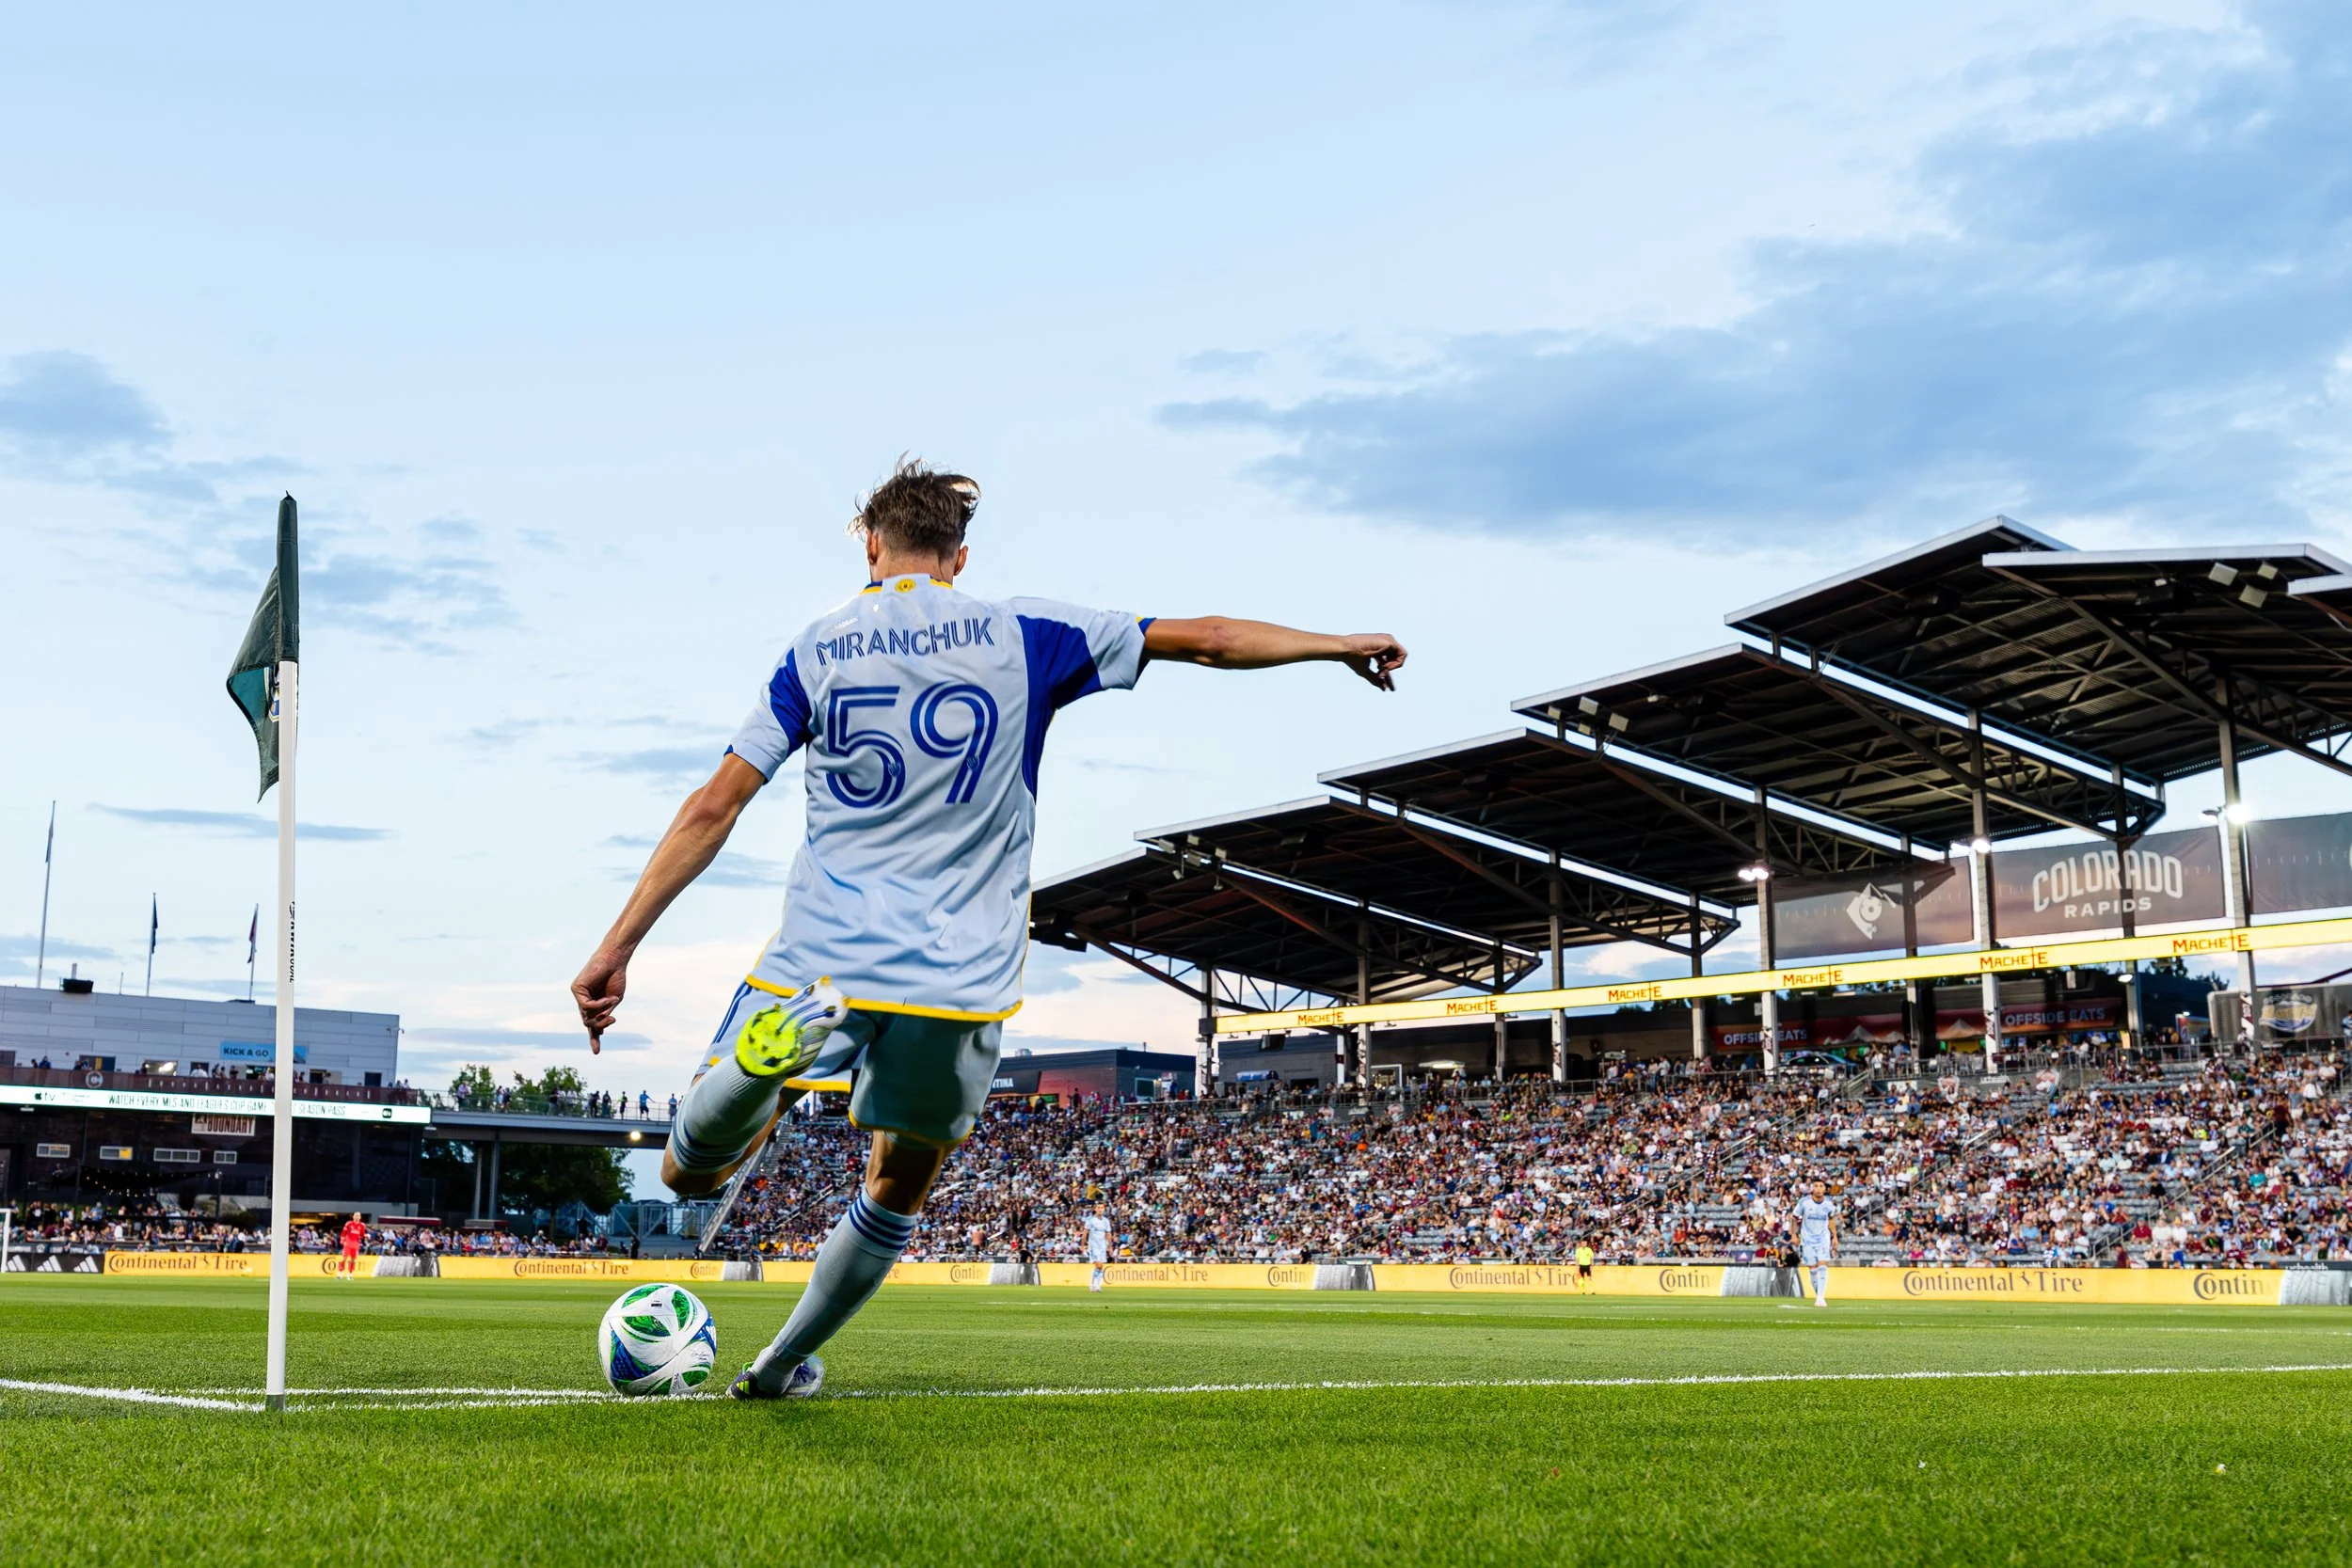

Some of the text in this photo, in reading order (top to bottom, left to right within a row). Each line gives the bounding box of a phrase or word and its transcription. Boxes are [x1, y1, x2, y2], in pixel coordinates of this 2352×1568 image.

[816, 616, 994, 666] MIRANCHUK
[825, 680, 999, 809] 59
[2032, 849, 2183, 913] COLORADO
[2064, 896, 2153, 919] RAPIDS
[2005, 1007, 2106, 1026] OFFSIDE EATS
[1724, 1032, 1763, 1046] OFFSI
[223, 1047, 245, 1055] KICK
[109, 1254, 247, 1273] Continental Tire
[514, 1260, 628, 1277] Continental Tire
[1103, 1265, 1208, 1285] Continental Tire
[1450, 1267, 1530, 1289] Continental
[1903, 1270, 2083, 1296] Continental Tire
